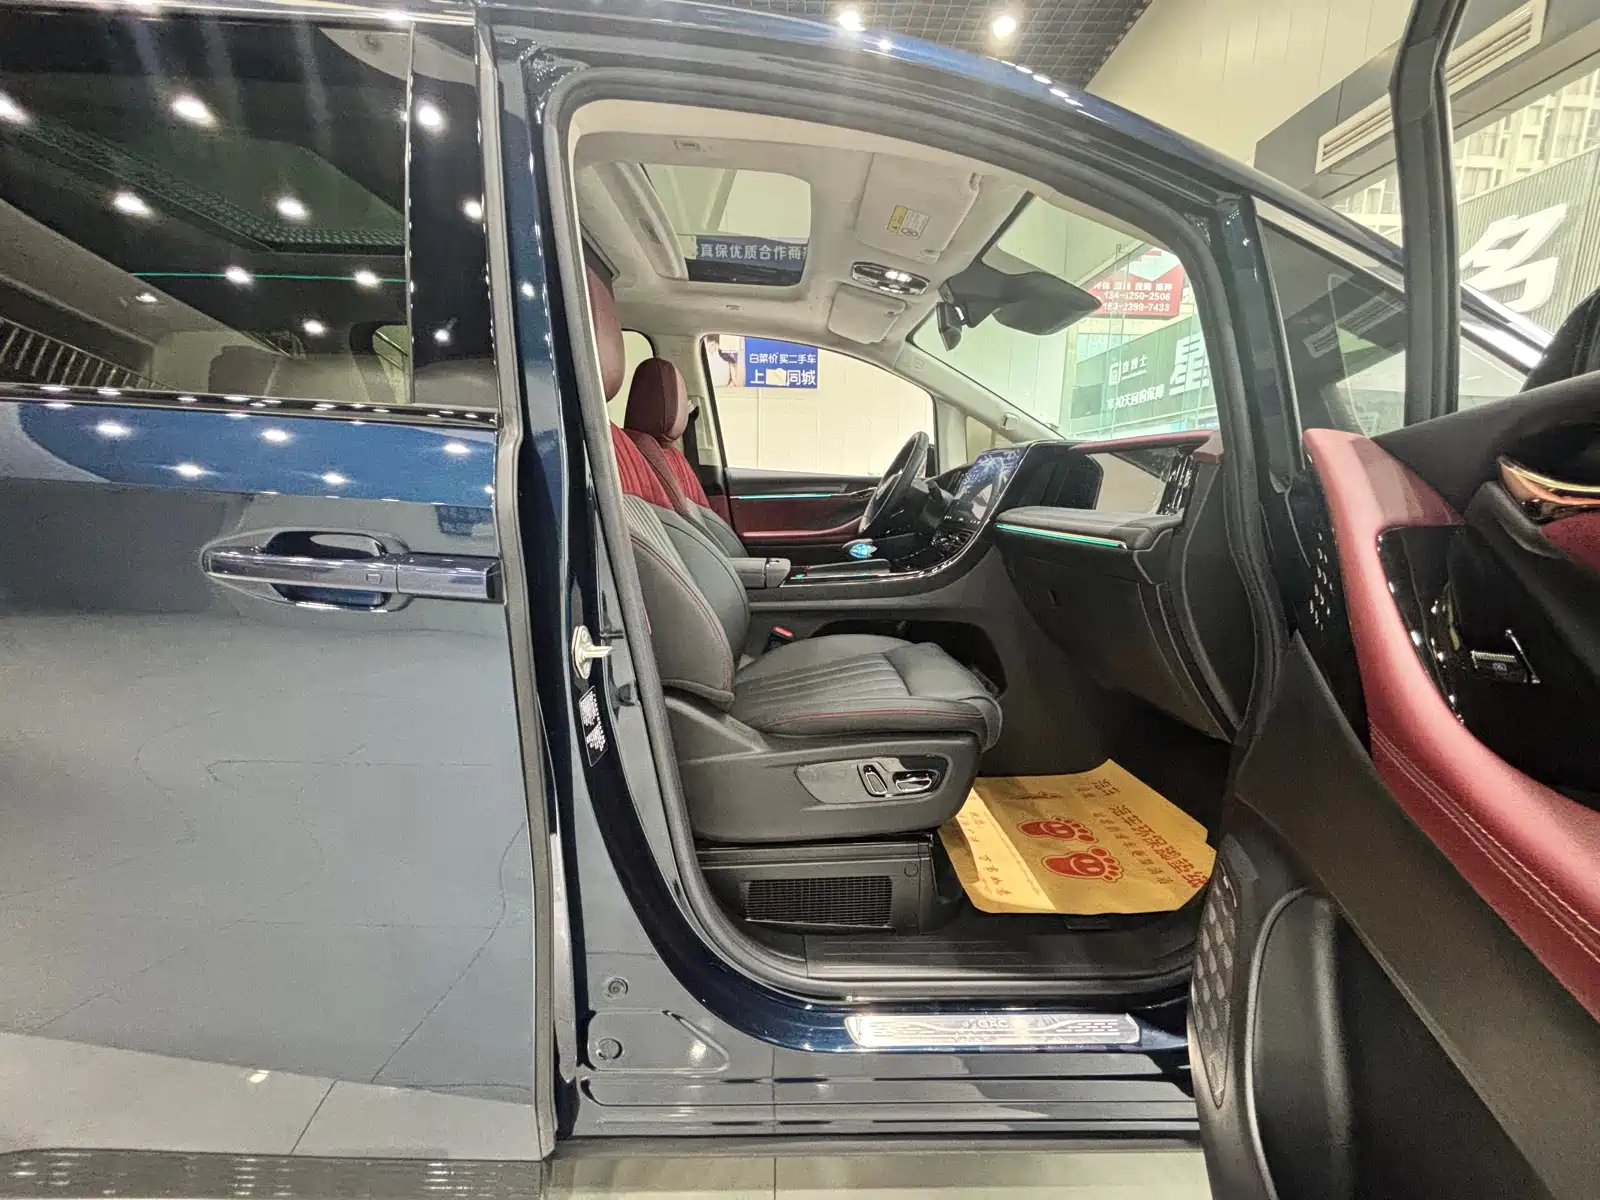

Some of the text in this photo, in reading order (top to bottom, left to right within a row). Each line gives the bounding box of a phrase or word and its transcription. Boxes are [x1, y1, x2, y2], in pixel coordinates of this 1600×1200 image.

[749, 352, 817, 365] 白菜价买二手车
[750, 368, 817, 386] 上同城
